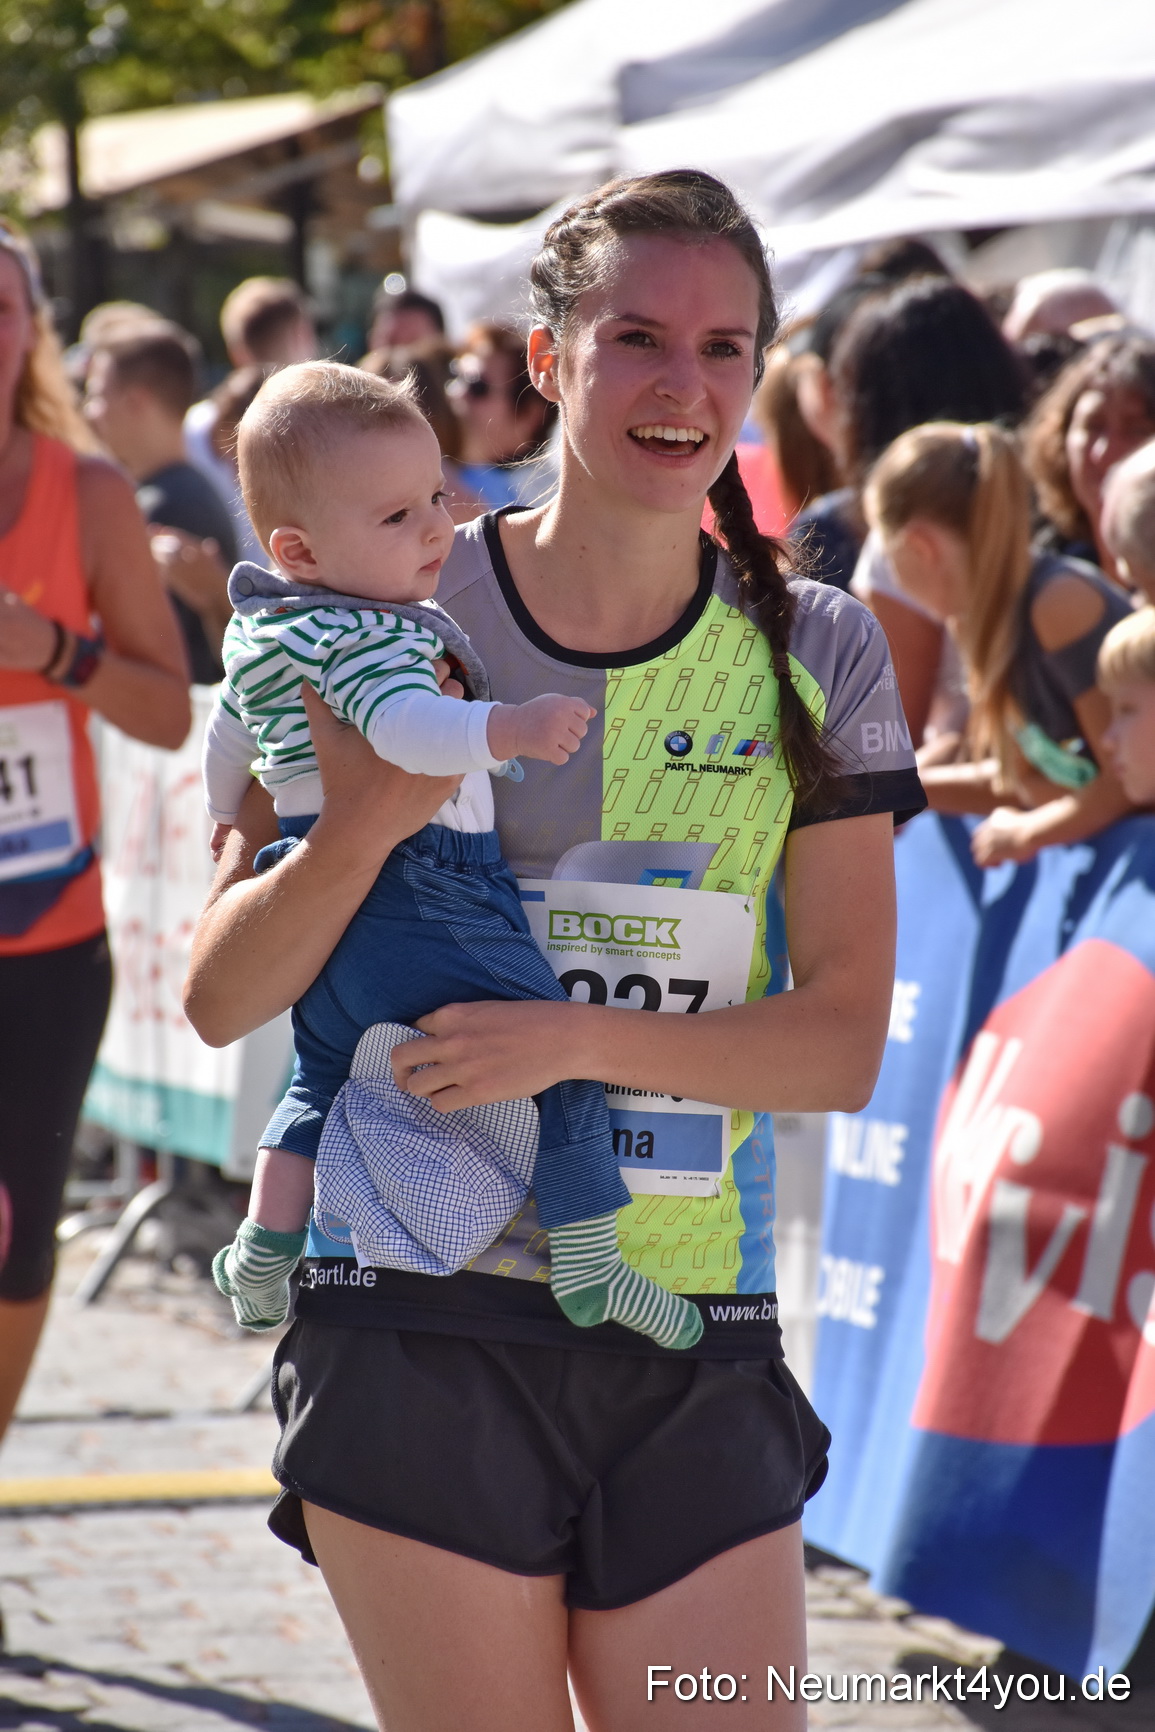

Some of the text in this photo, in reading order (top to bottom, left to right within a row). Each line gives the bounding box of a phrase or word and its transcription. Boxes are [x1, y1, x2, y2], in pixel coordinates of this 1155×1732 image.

[665, 762, 754, 776] PARTL NEUMARKT
[548, 910, 682, 949] BOCK
[547, 942, 681, 961] inspired by smart concepts
[612, 1128, 655, 1159] na
